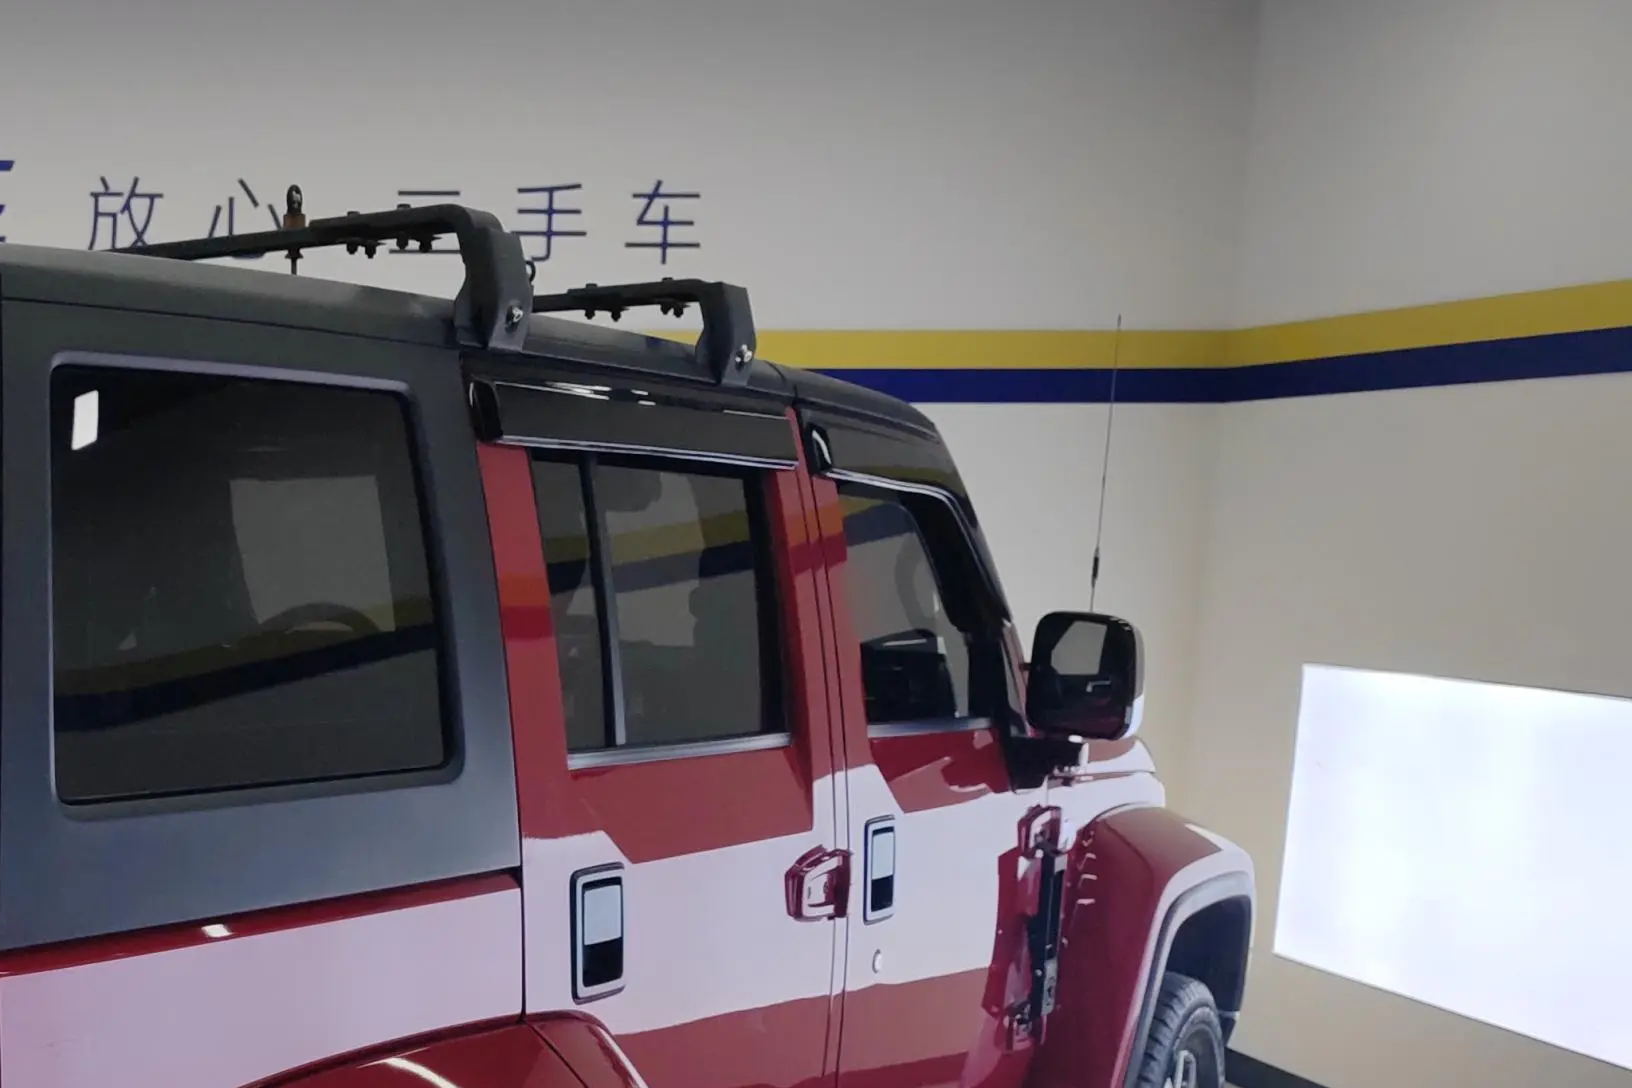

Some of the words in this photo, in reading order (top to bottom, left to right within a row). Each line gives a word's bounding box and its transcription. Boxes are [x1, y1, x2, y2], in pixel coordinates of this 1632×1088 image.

[88, 175, 702, 264] 放心二手车
